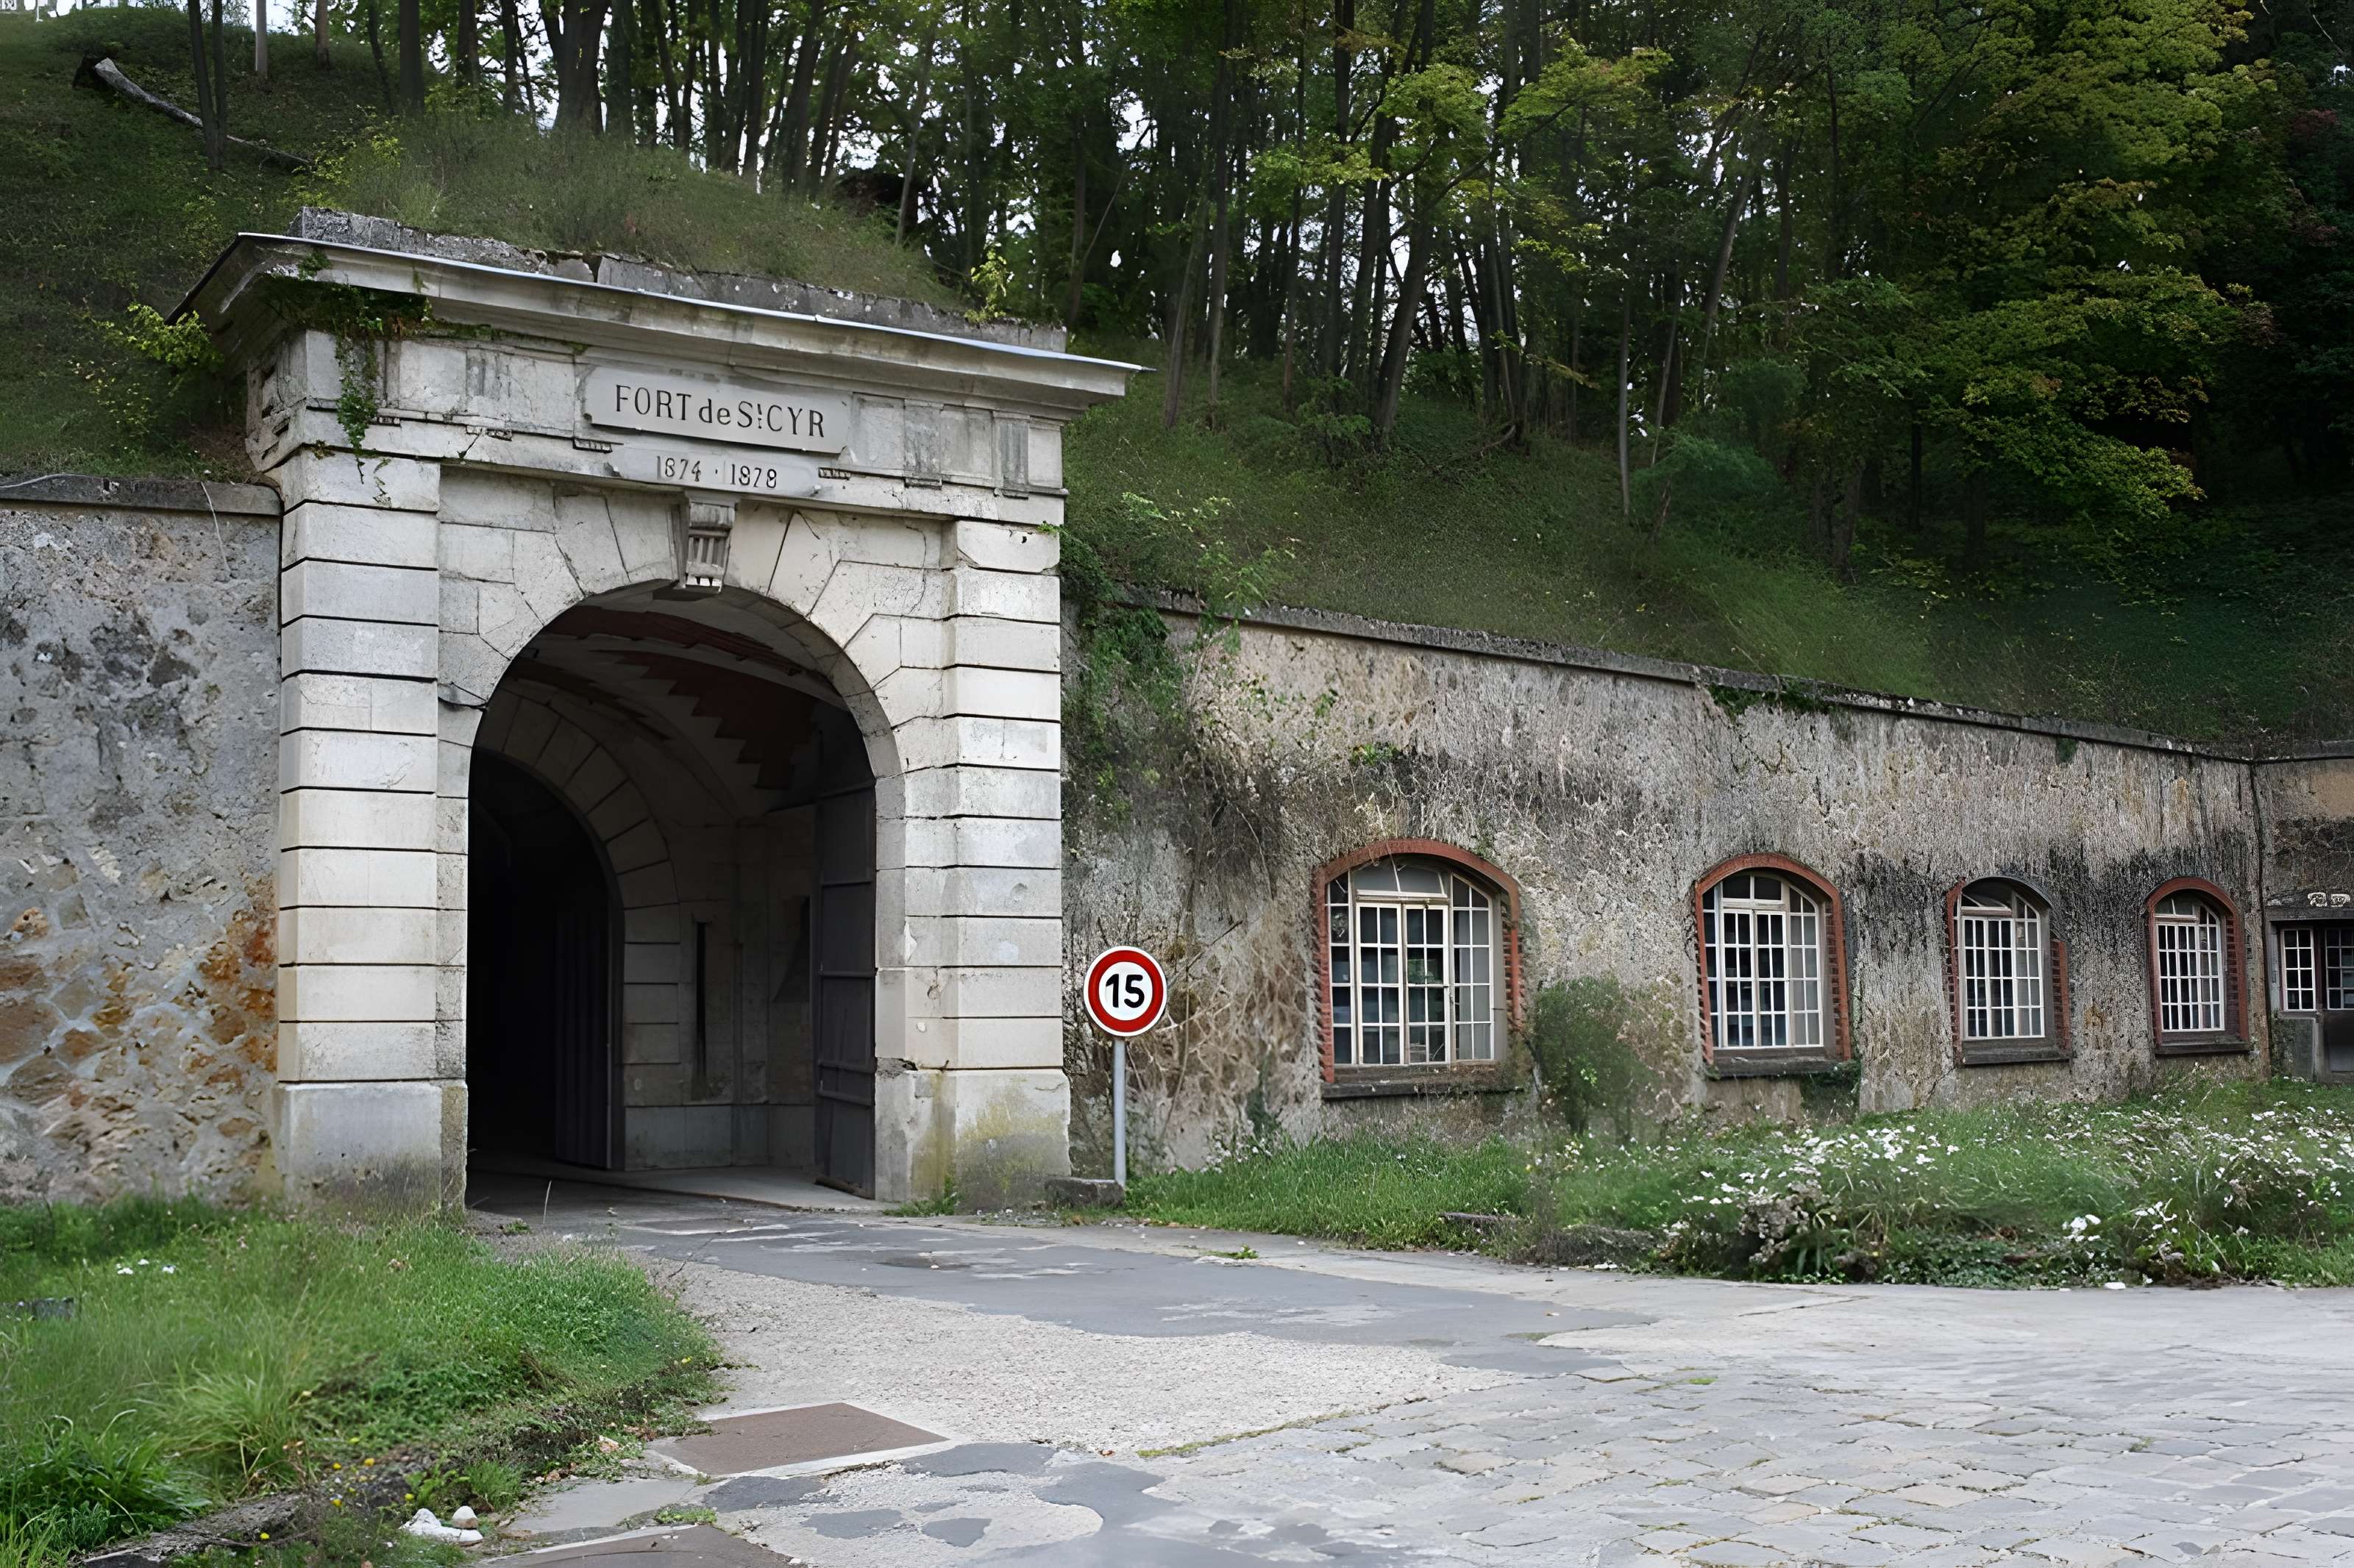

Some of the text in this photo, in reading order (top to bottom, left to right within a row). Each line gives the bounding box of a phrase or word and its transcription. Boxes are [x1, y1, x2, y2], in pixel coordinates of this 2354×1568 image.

[616, 384, 691, 421] FORT
[698, 398, 731, 425] de
[656, 455, 778, 489] 1874 1878
[1105, 973, 1145, 1009] 15
